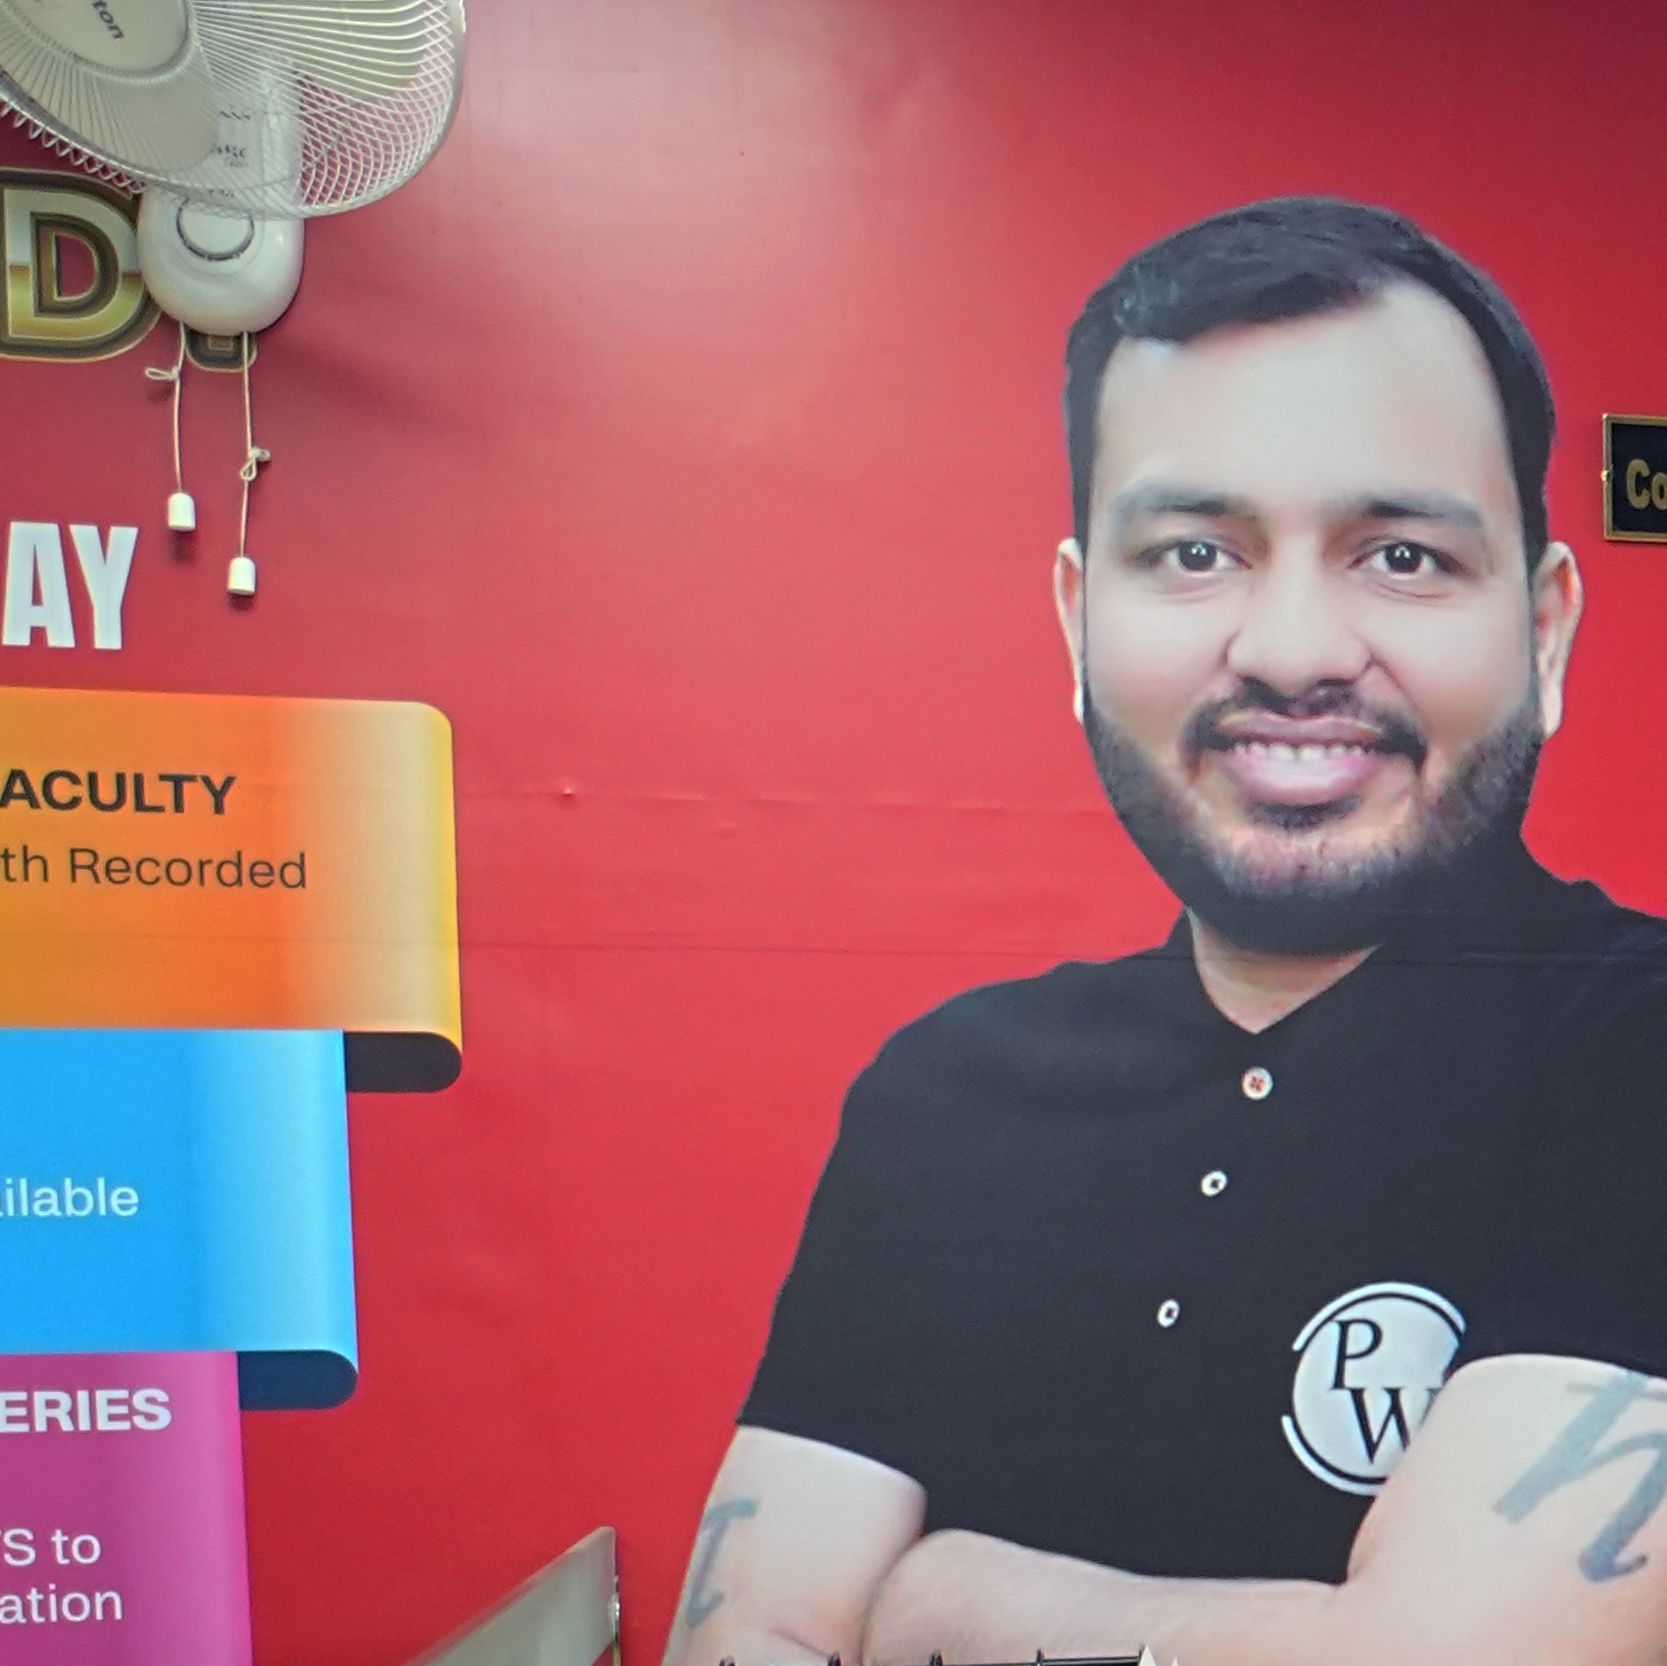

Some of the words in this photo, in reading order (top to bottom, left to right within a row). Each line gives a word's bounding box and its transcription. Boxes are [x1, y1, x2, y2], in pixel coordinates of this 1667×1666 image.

[70, 847, 307, 889] Recorded
[0, 1178, 139, 1218] ilable
[52, 1529, 101, 1566] to
